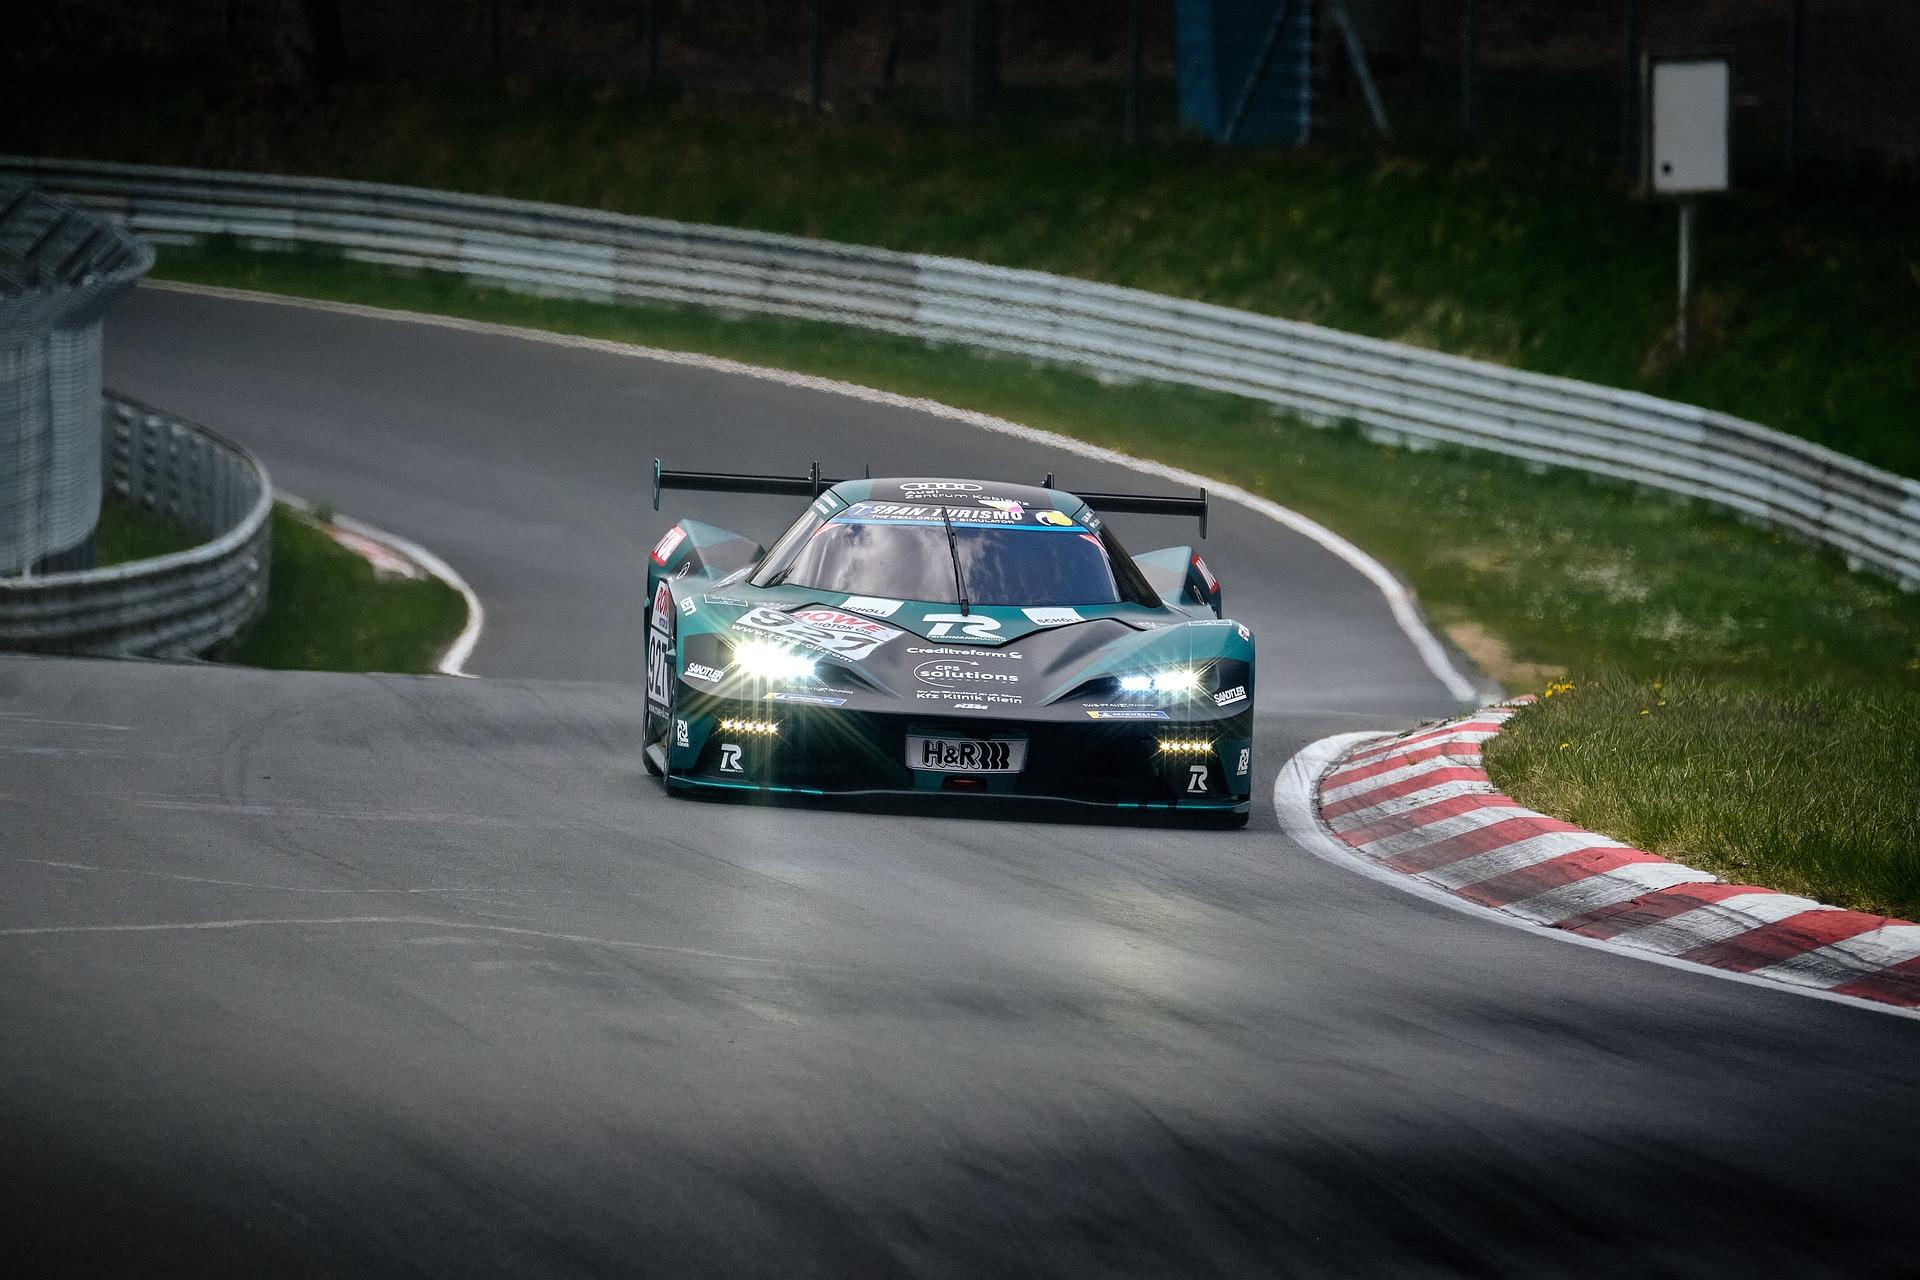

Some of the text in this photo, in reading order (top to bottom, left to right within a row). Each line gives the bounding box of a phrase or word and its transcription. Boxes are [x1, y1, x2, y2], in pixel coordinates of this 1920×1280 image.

[750, 610, 878, 651] 927
[792, 611, 884, 633] ROWE
[813, 622, 853, 632] MOTOR
[906, 648, 1007, 658] Creditreform
[687, 662, 724, 680] SANDTLER
[920, 670, 1019, 682] solutions
[987, 696, 1022, 704] Klein
[1213, 685, 1246, 704] SANDTLER
[922, 739, 981, 770] H&R
